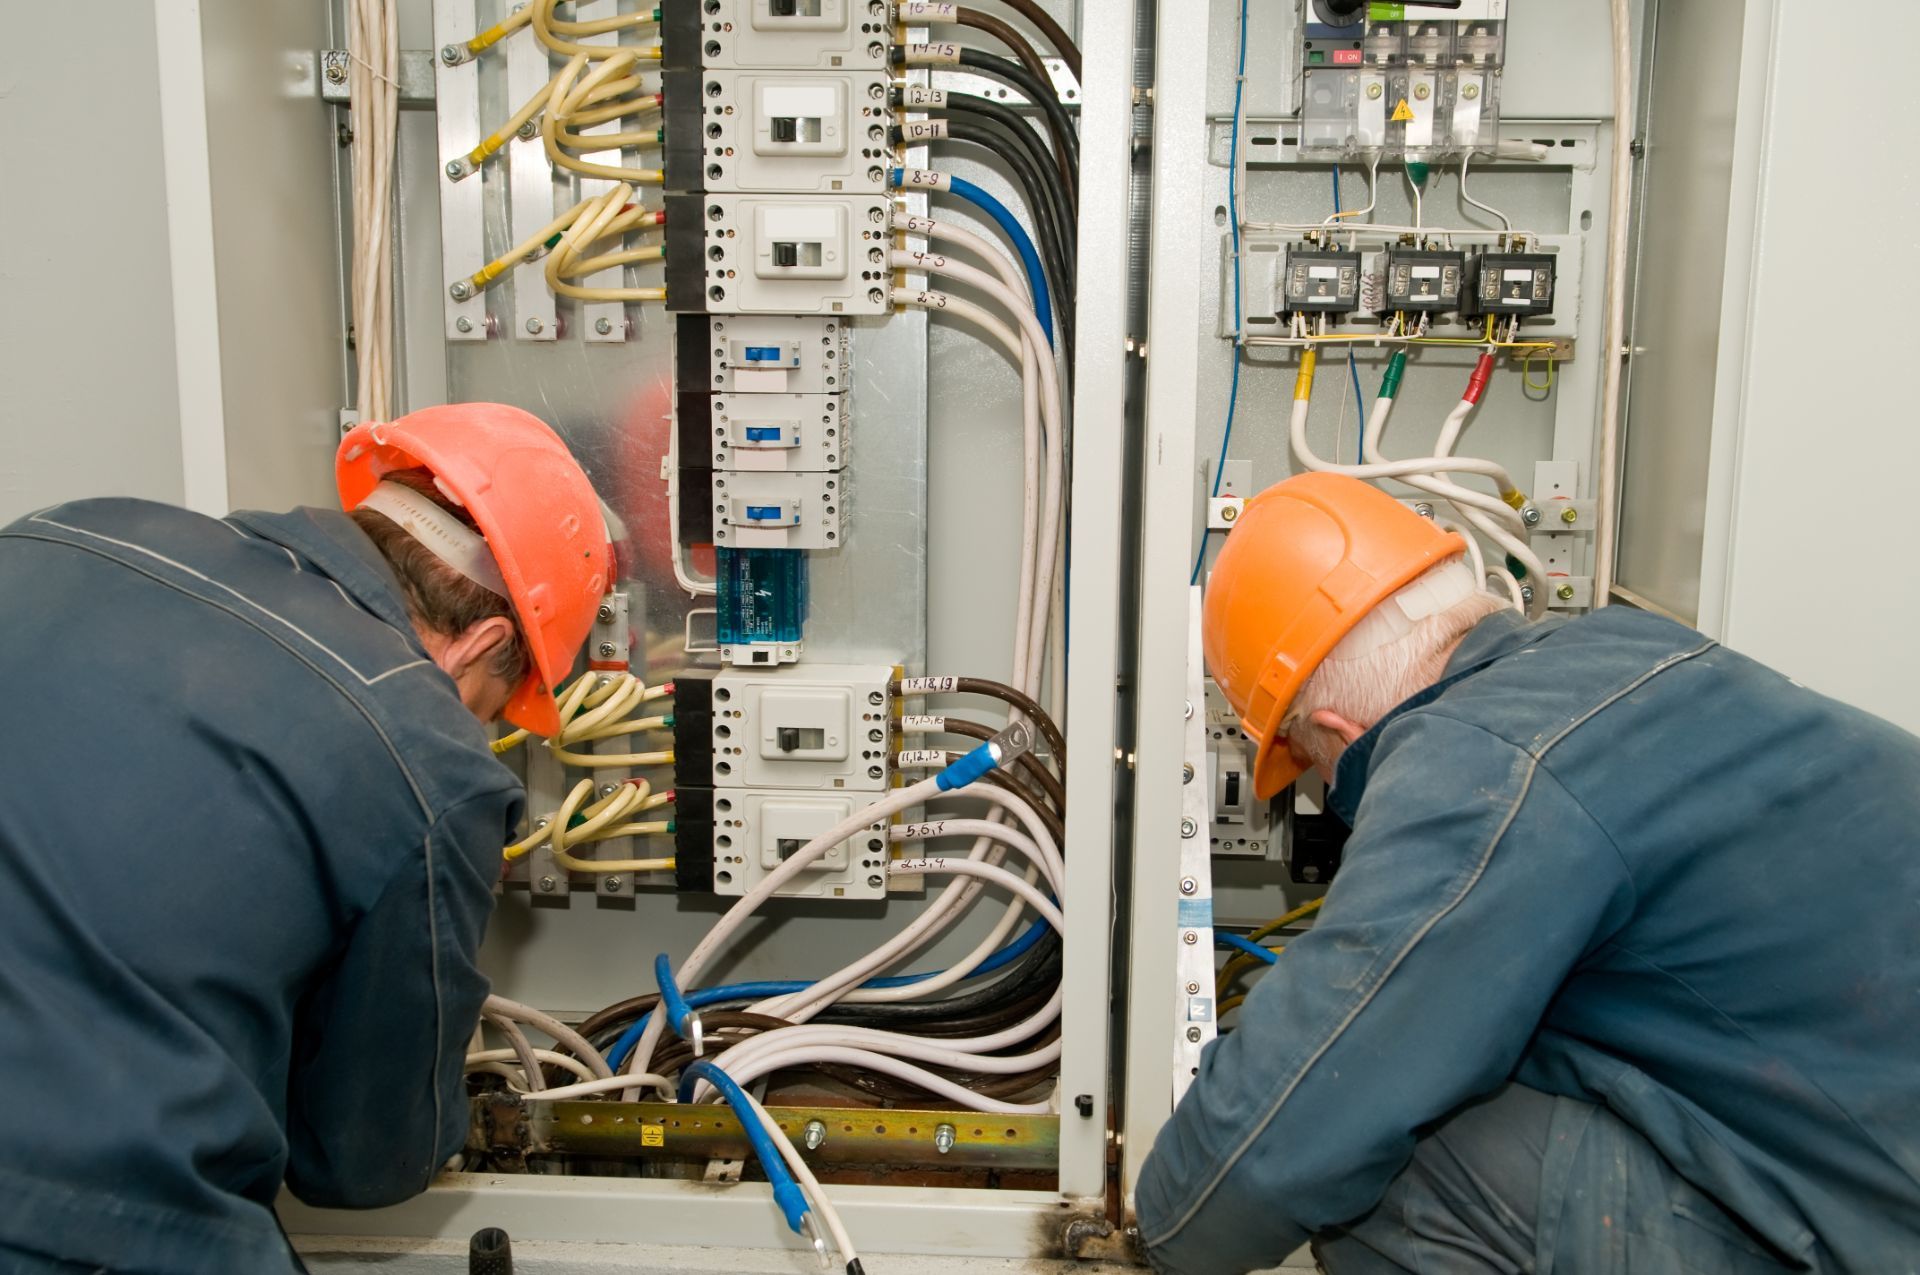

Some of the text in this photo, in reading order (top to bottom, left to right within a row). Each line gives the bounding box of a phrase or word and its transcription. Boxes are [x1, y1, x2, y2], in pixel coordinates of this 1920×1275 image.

[910, 90, 942, 104] 12-13
[910, 124, 940, 137] 10-11
[912, 170, 939, 185] 8-9
[908, 217, 936, 233] 6-7
[917, 292, 947, 307] 2-3
